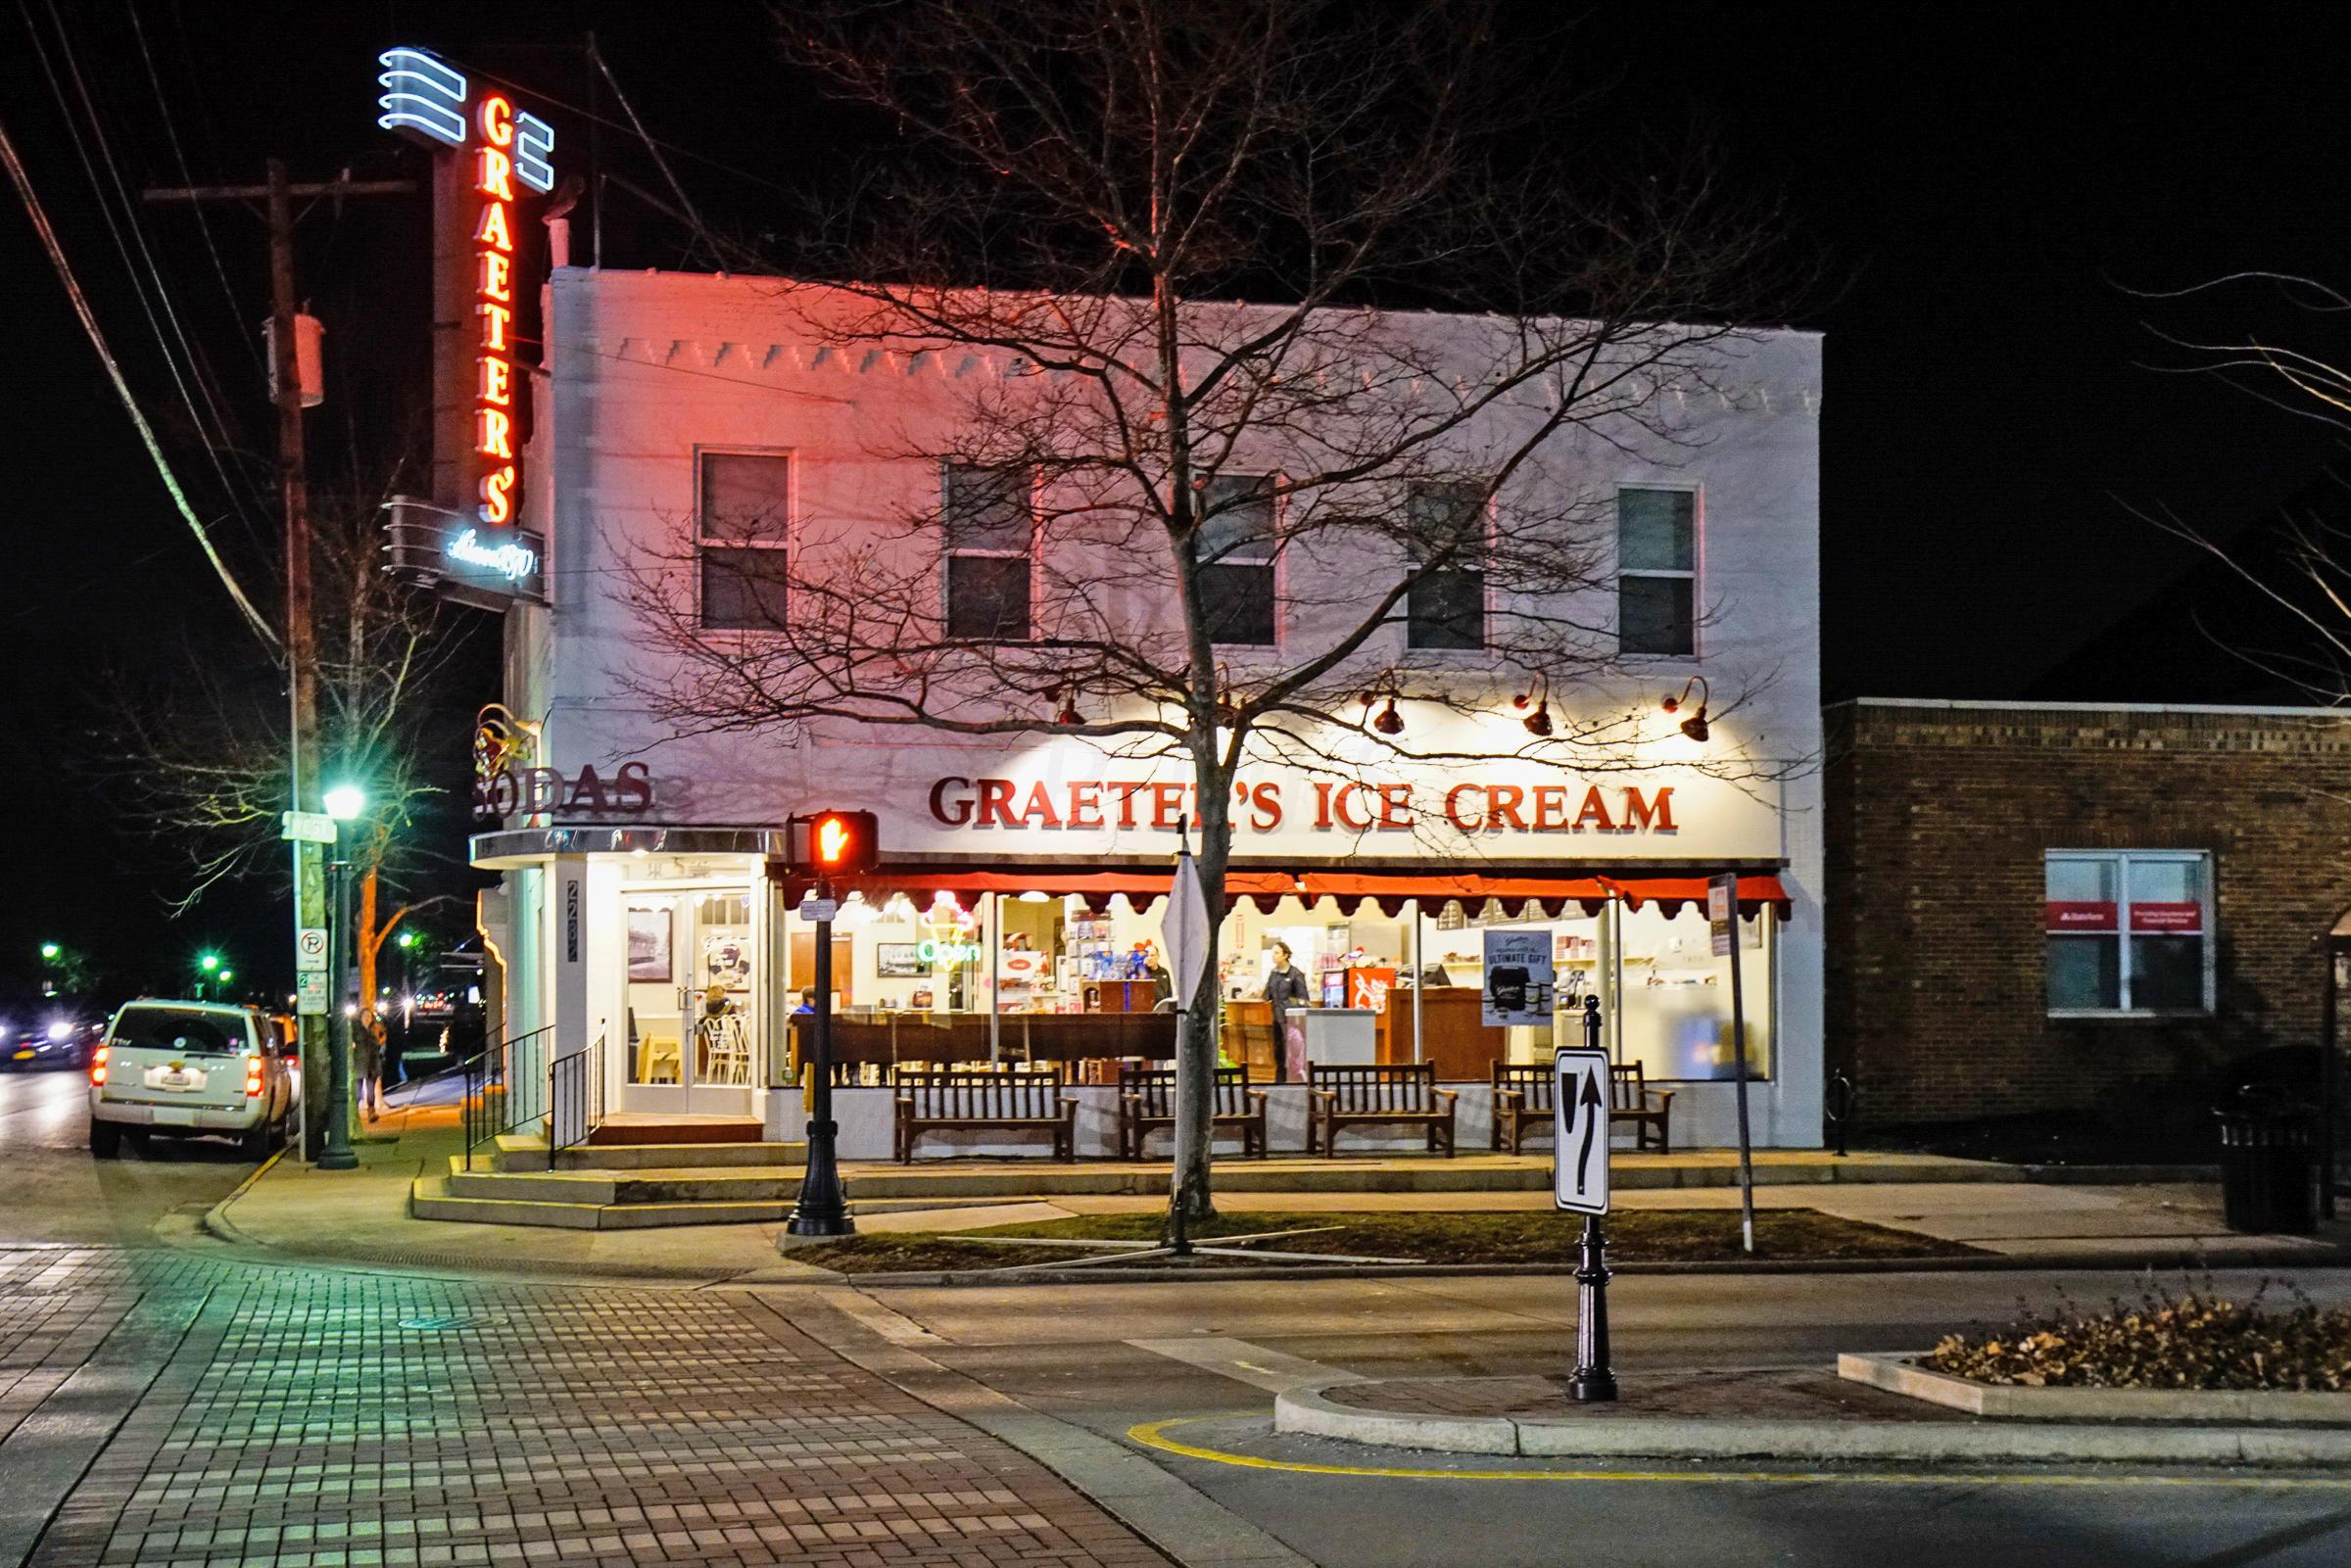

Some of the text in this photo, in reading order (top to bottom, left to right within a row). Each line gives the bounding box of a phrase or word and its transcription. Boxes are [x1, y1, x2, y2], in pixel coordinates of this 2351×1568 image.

[473, 761, 652, 823] SODAS
[930, 776, 1679, 832] GRAETE'S ICE CREAM
[917, 938, 981, 966] Open
[1488, 953, 1525, 965] ULTIMATE
